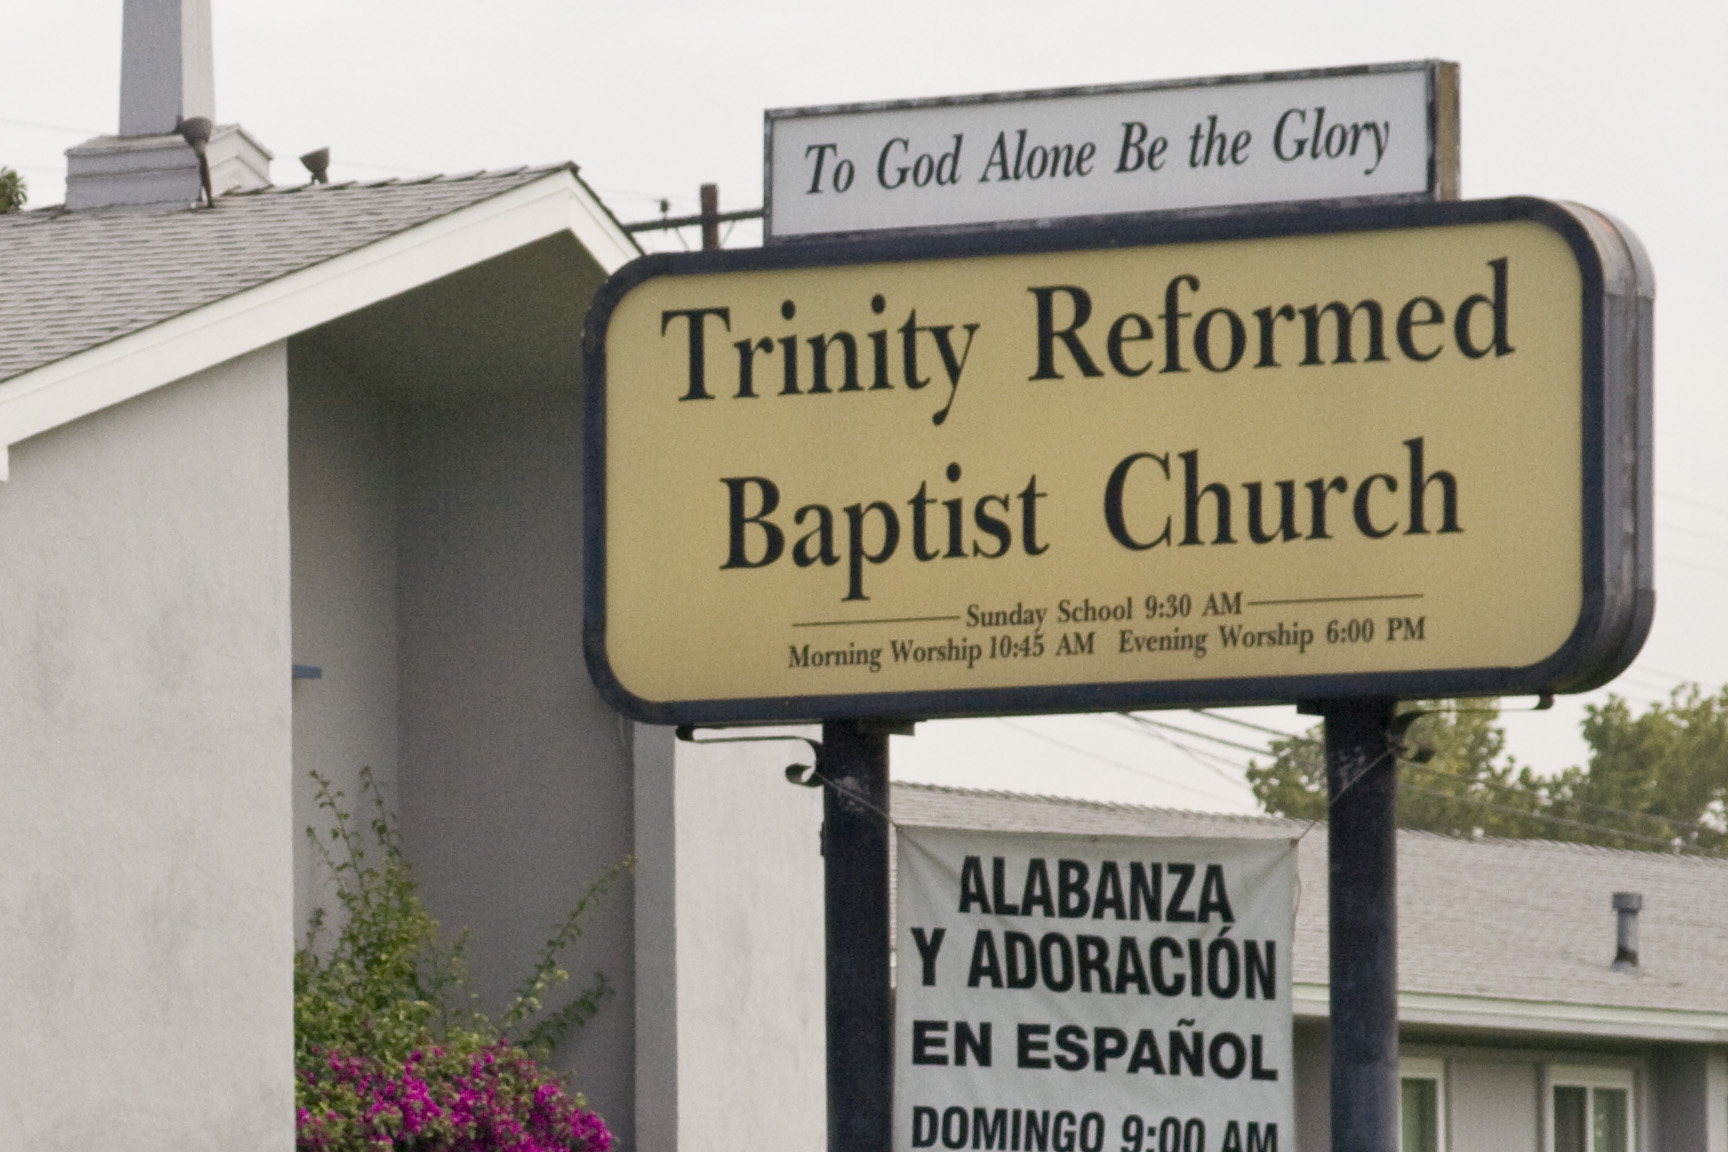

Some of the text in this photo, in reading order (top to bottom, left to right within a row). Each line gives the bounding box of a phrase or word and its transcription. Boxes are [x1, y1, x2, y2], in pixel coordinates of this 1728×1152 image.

[804, 107, 1391, 194] To God Alone Be the Glory
[660, 256, 1516, 427] Trinity Reformed
[719, 436, 1465, 601] Baptist Church
[788, 615, 1427, 674] Morning Worship 10:45 AM Evening Worship 6:00 PM
[966, 591, 1243, 632] Sunday School 9:30 AM
[958, 855, 1235, 924] ALABANZA
[911, 925, 1277, 1001] Y ADORACIÓN
[912, 1018, 1278, 1082] EN ESPAÑOL
